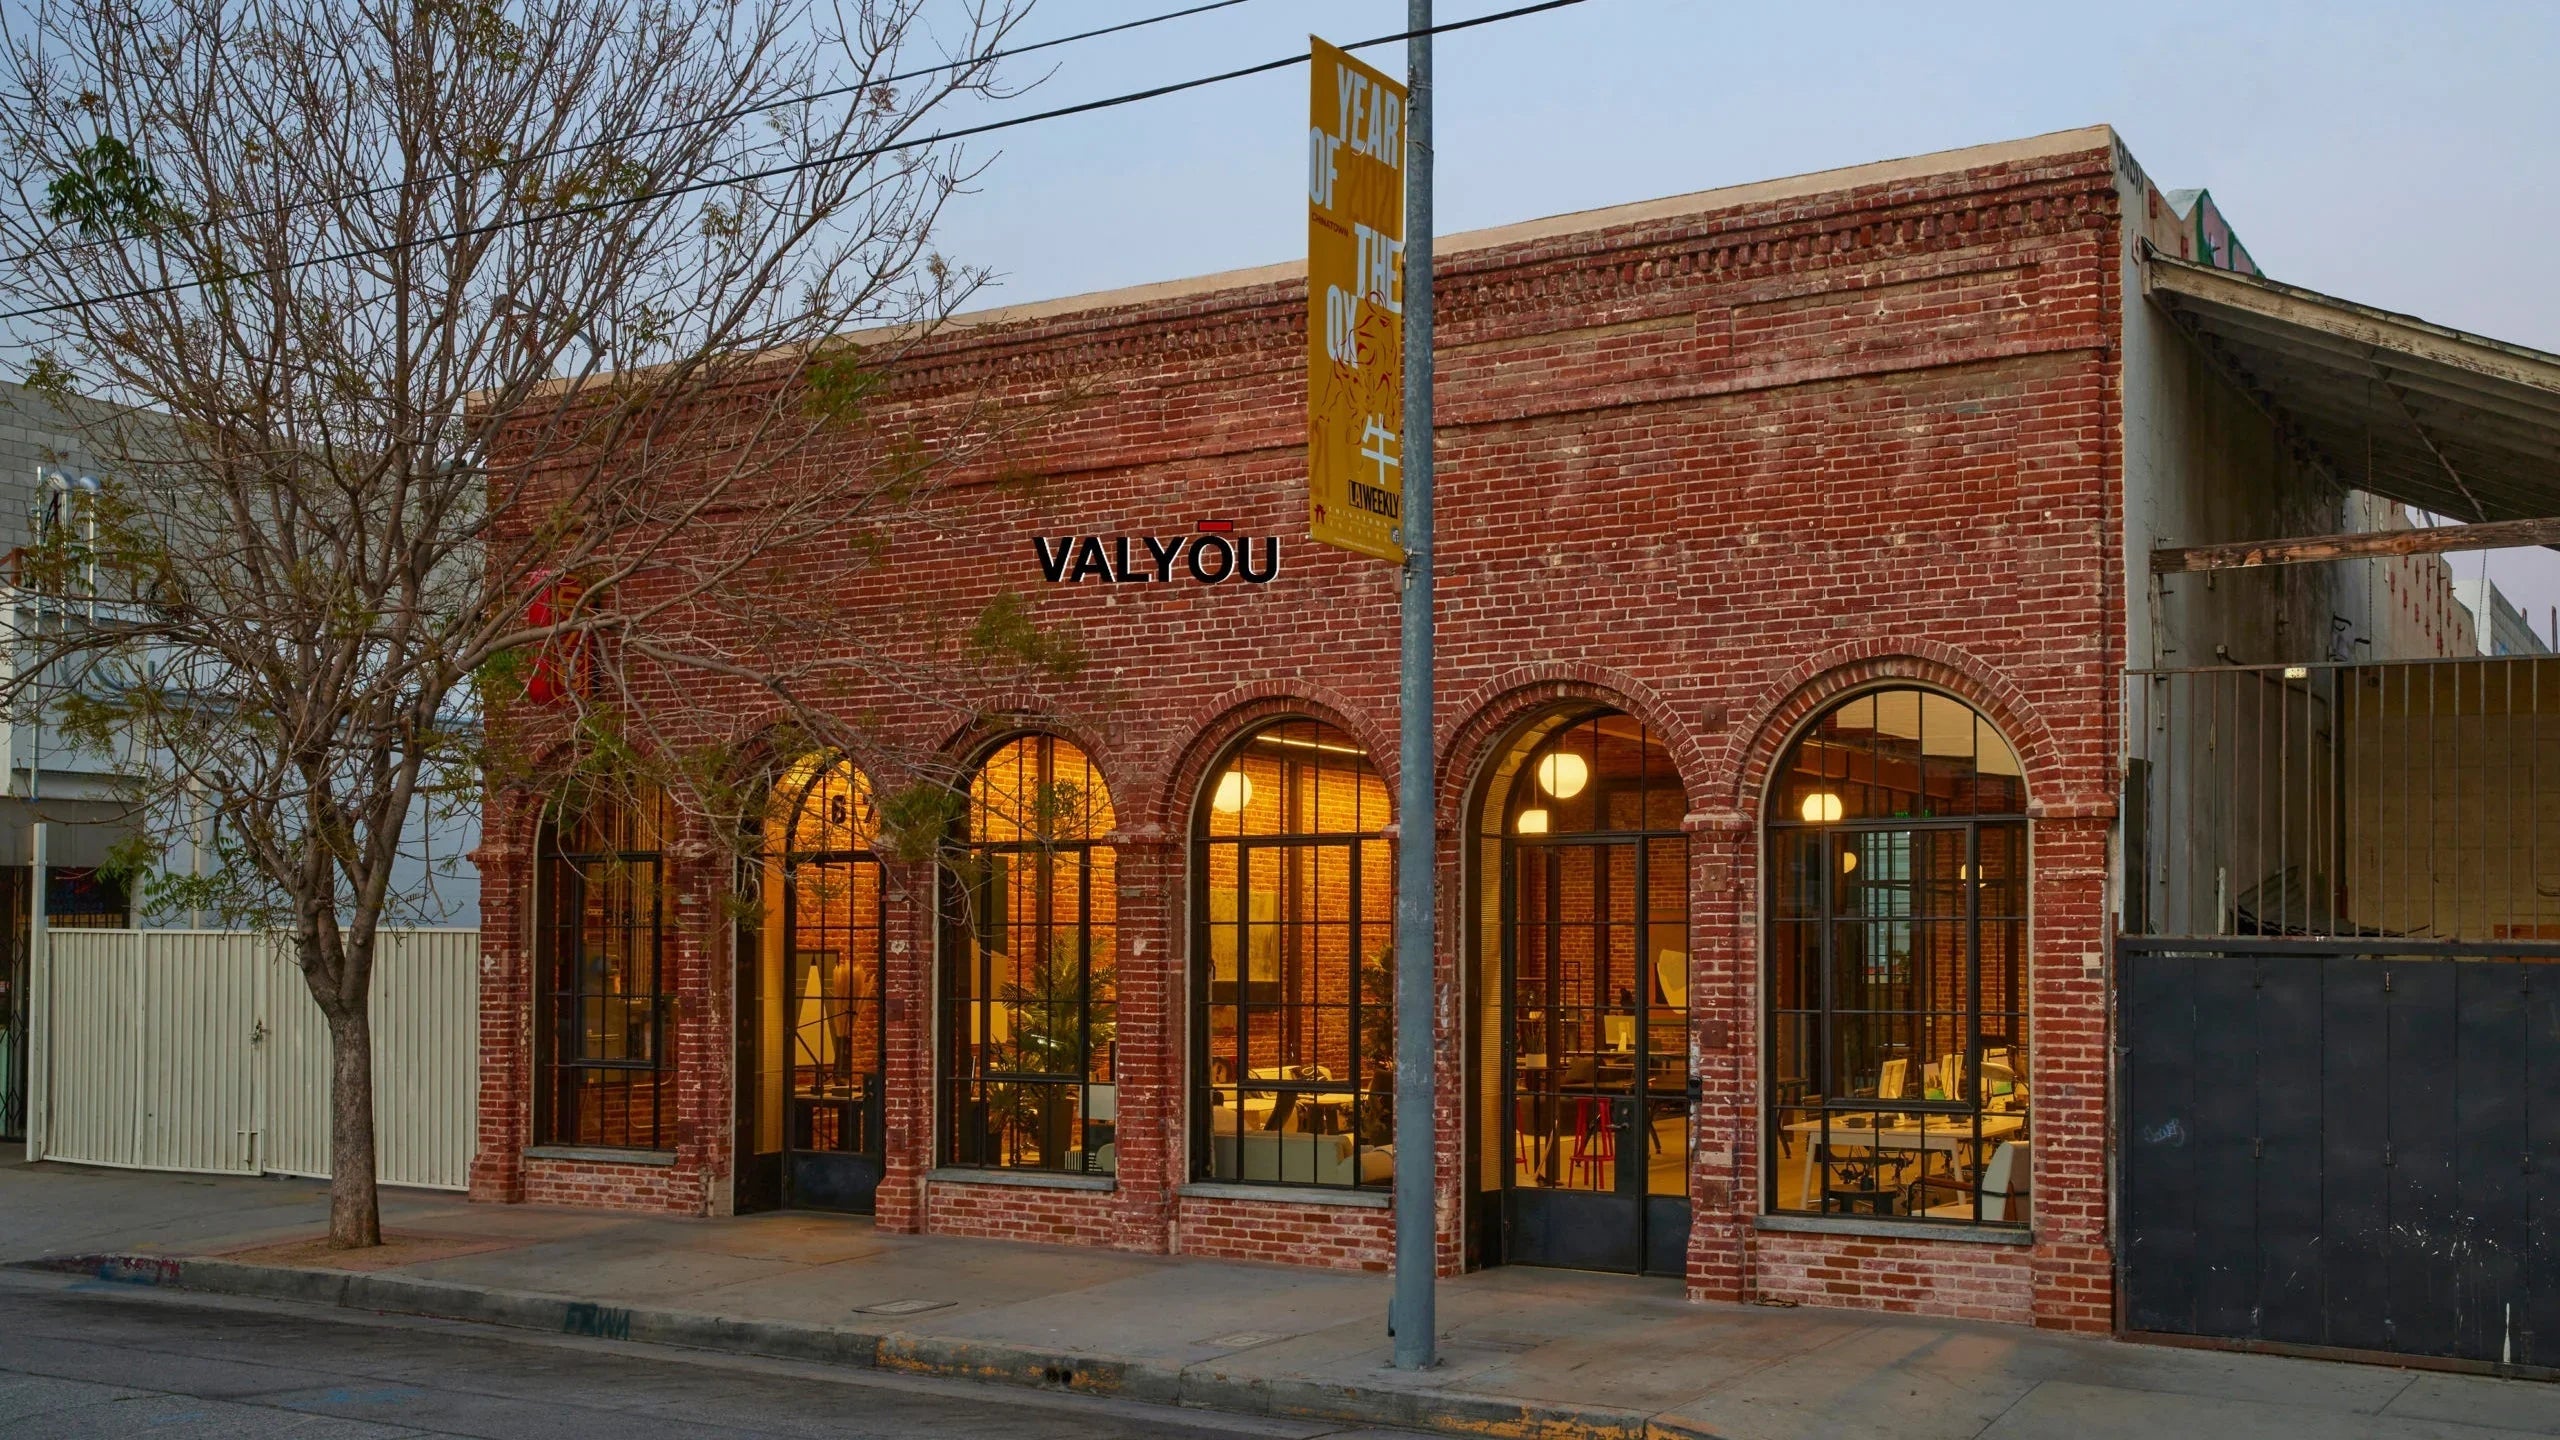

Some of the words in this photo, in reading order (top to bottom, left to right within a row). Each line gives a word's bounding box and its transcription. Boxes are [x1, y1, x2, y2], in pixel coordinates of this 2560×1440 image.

[1337, 63, 1398, 169] YEAR
[1309, 126, 1341, 210] OF
[1311, 212, 1349, 237] CHINATOWN
[1354, 222, 1404, 314] THE
[1326, 284, 1358, 370] OX
[1362, 484, 1400, 520] WEEKLY
